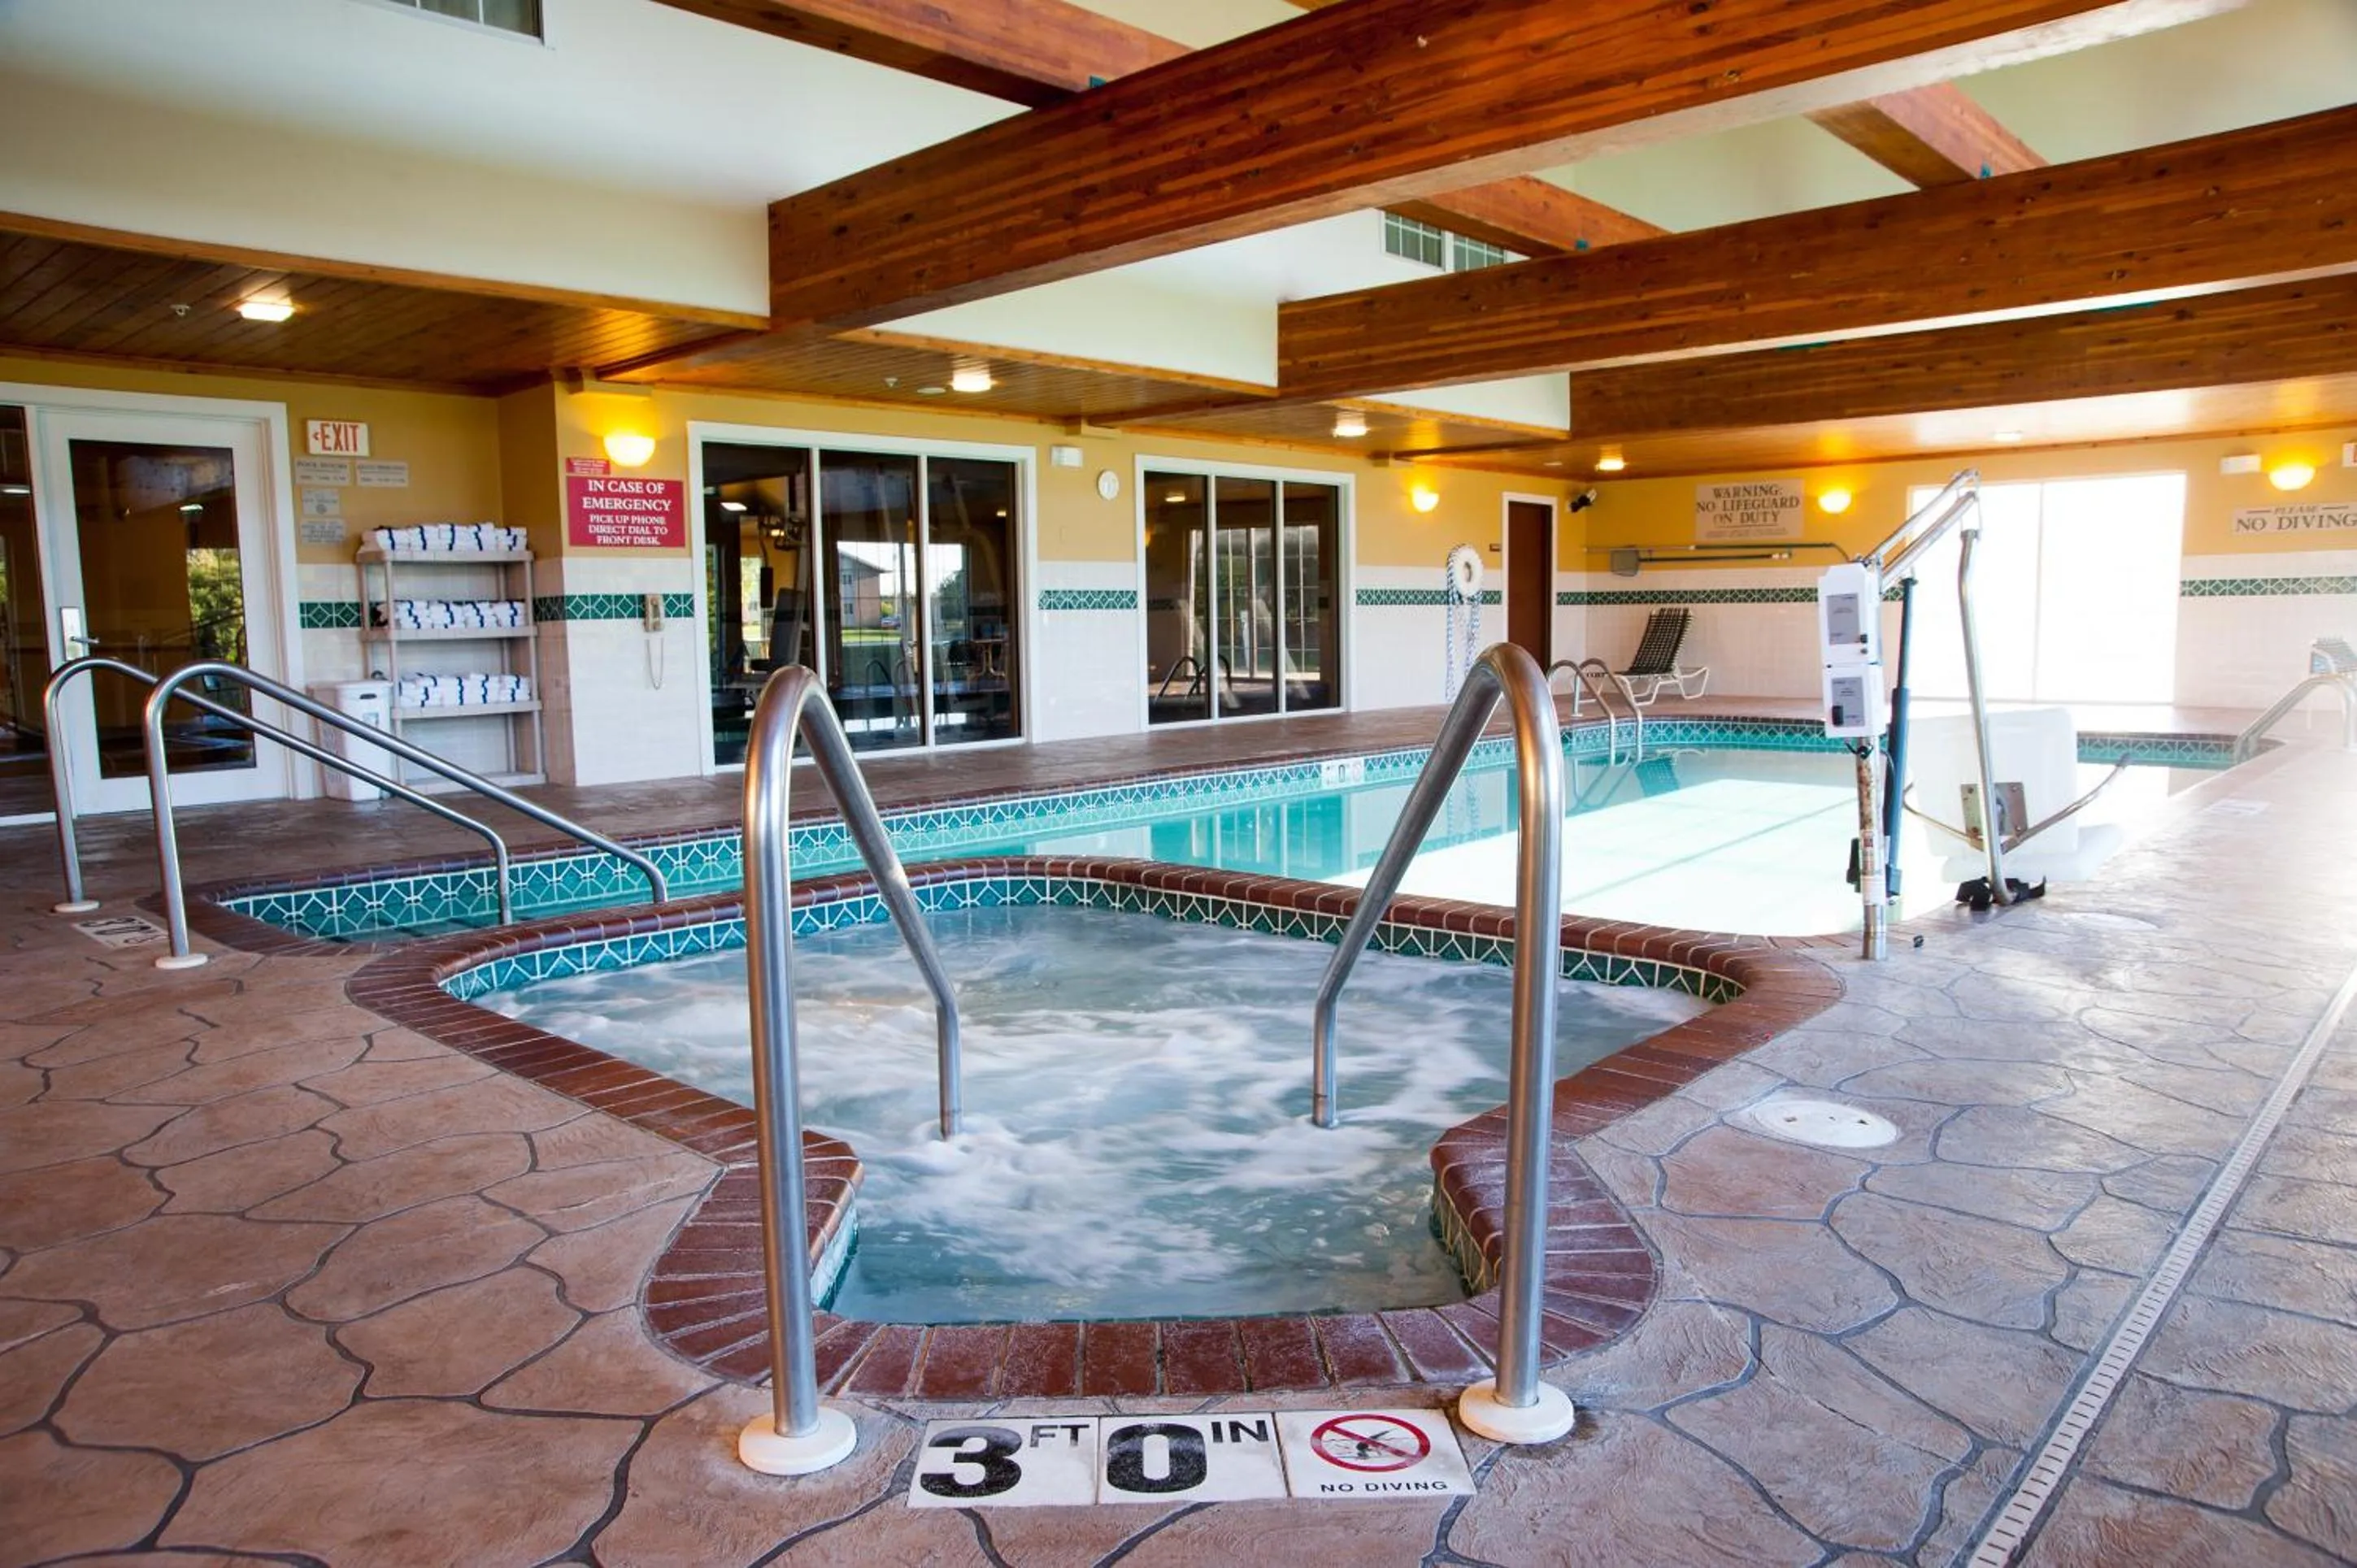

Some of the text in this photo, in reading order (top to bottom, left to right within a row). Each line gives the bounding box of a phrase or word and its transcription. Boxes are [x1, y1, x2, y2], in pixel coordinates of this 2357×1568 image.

[320, 422, 359, 453] EXIT
[588, 480, 665, 494] IN CASE OF
[582, 497, 672, 511] EMERGENCY
[1696, 496, 1800, 512] NO LIFEGUARD
[589, 514, 614, 523] PICK
[615, 515, 629, 524] UP
[1712, 510, 1781, 524] ON DUTY
[2237, 513, 2357, 532] NO DIVING
[588, 524, 668, 535] DIRECT DIAL TO
[597, 535, 632, 545] FRONT
[920, 1420, 1269, 1498] 3 FT 0 IN
[1320, 1481, 1448, 1493] NO DIVING
